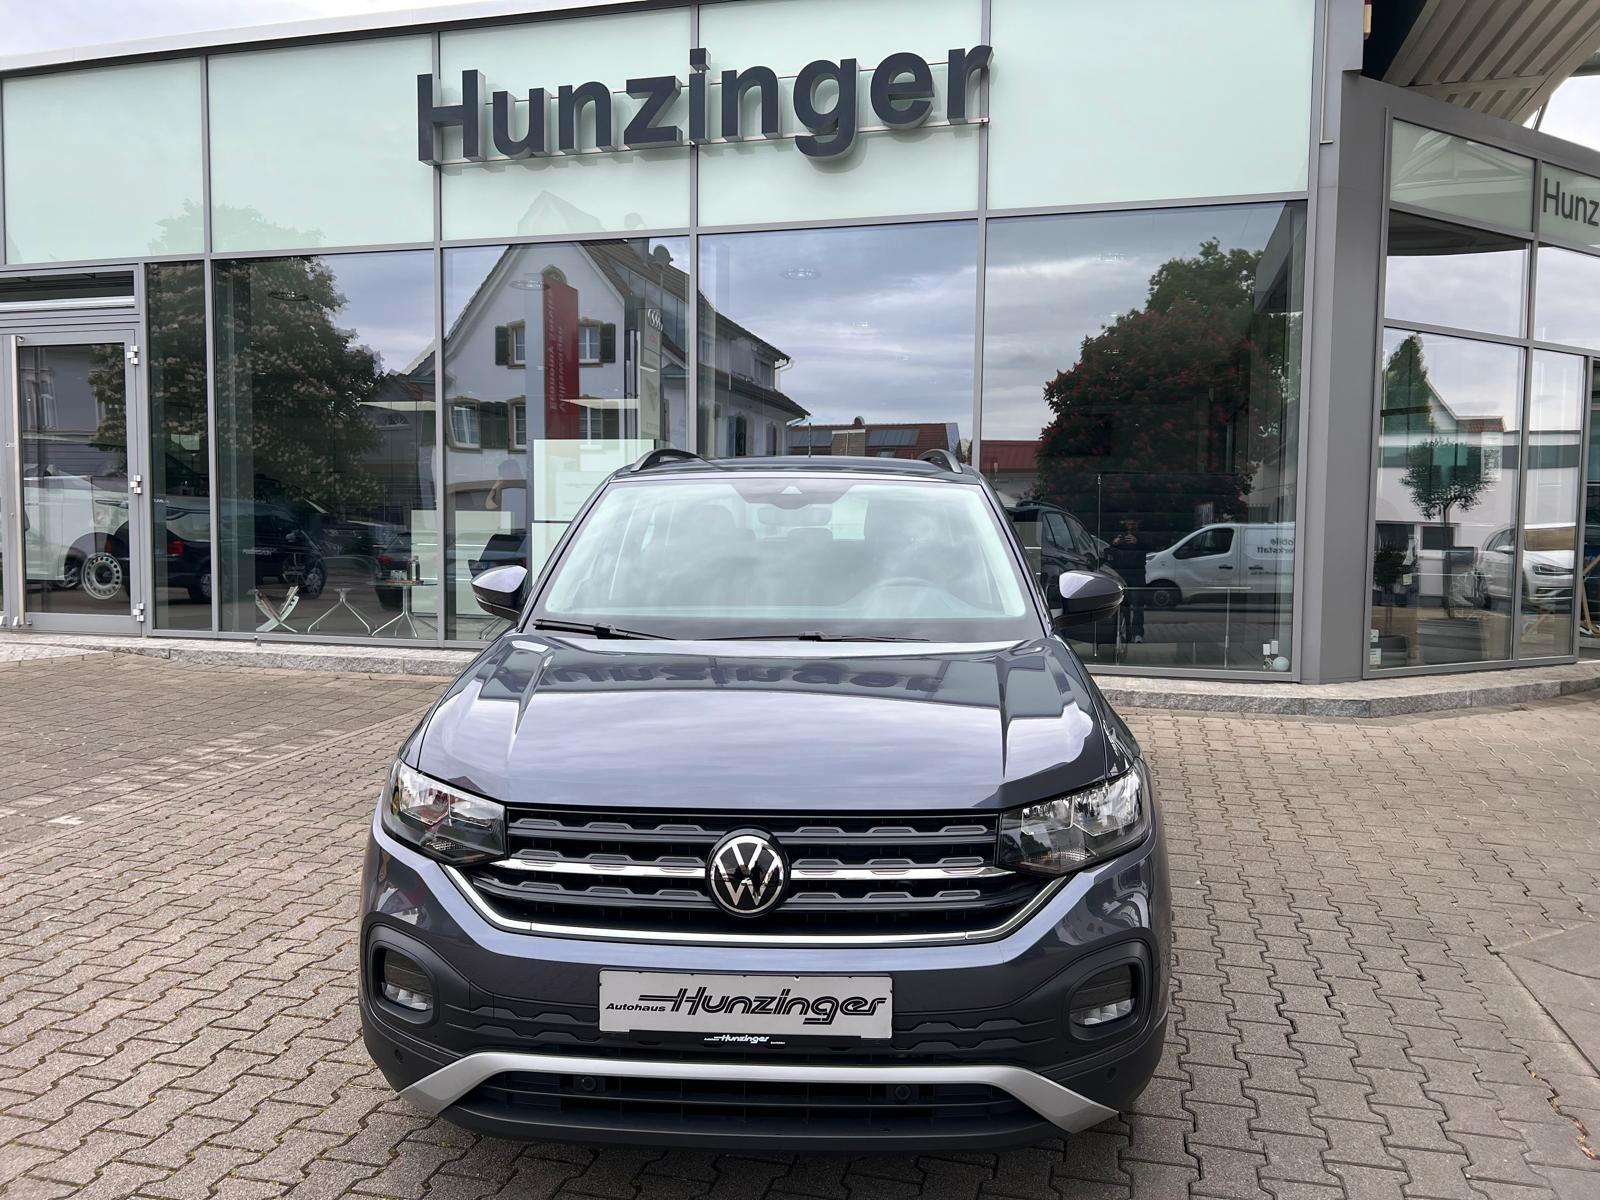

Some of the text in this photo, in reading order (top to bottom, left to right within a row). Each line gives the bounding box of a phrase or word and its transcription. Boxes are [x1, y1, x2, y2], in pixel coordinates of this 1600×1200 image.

[417, 45, 994, 165] Hunzinger
[1543, 177, 1600, 227] Hunz
[711, 835, 784, 914] VW
[605, 986, 888, 1025] Autohaus Hunzinger
[714, 1034, 769, 1044] Hunzinger
